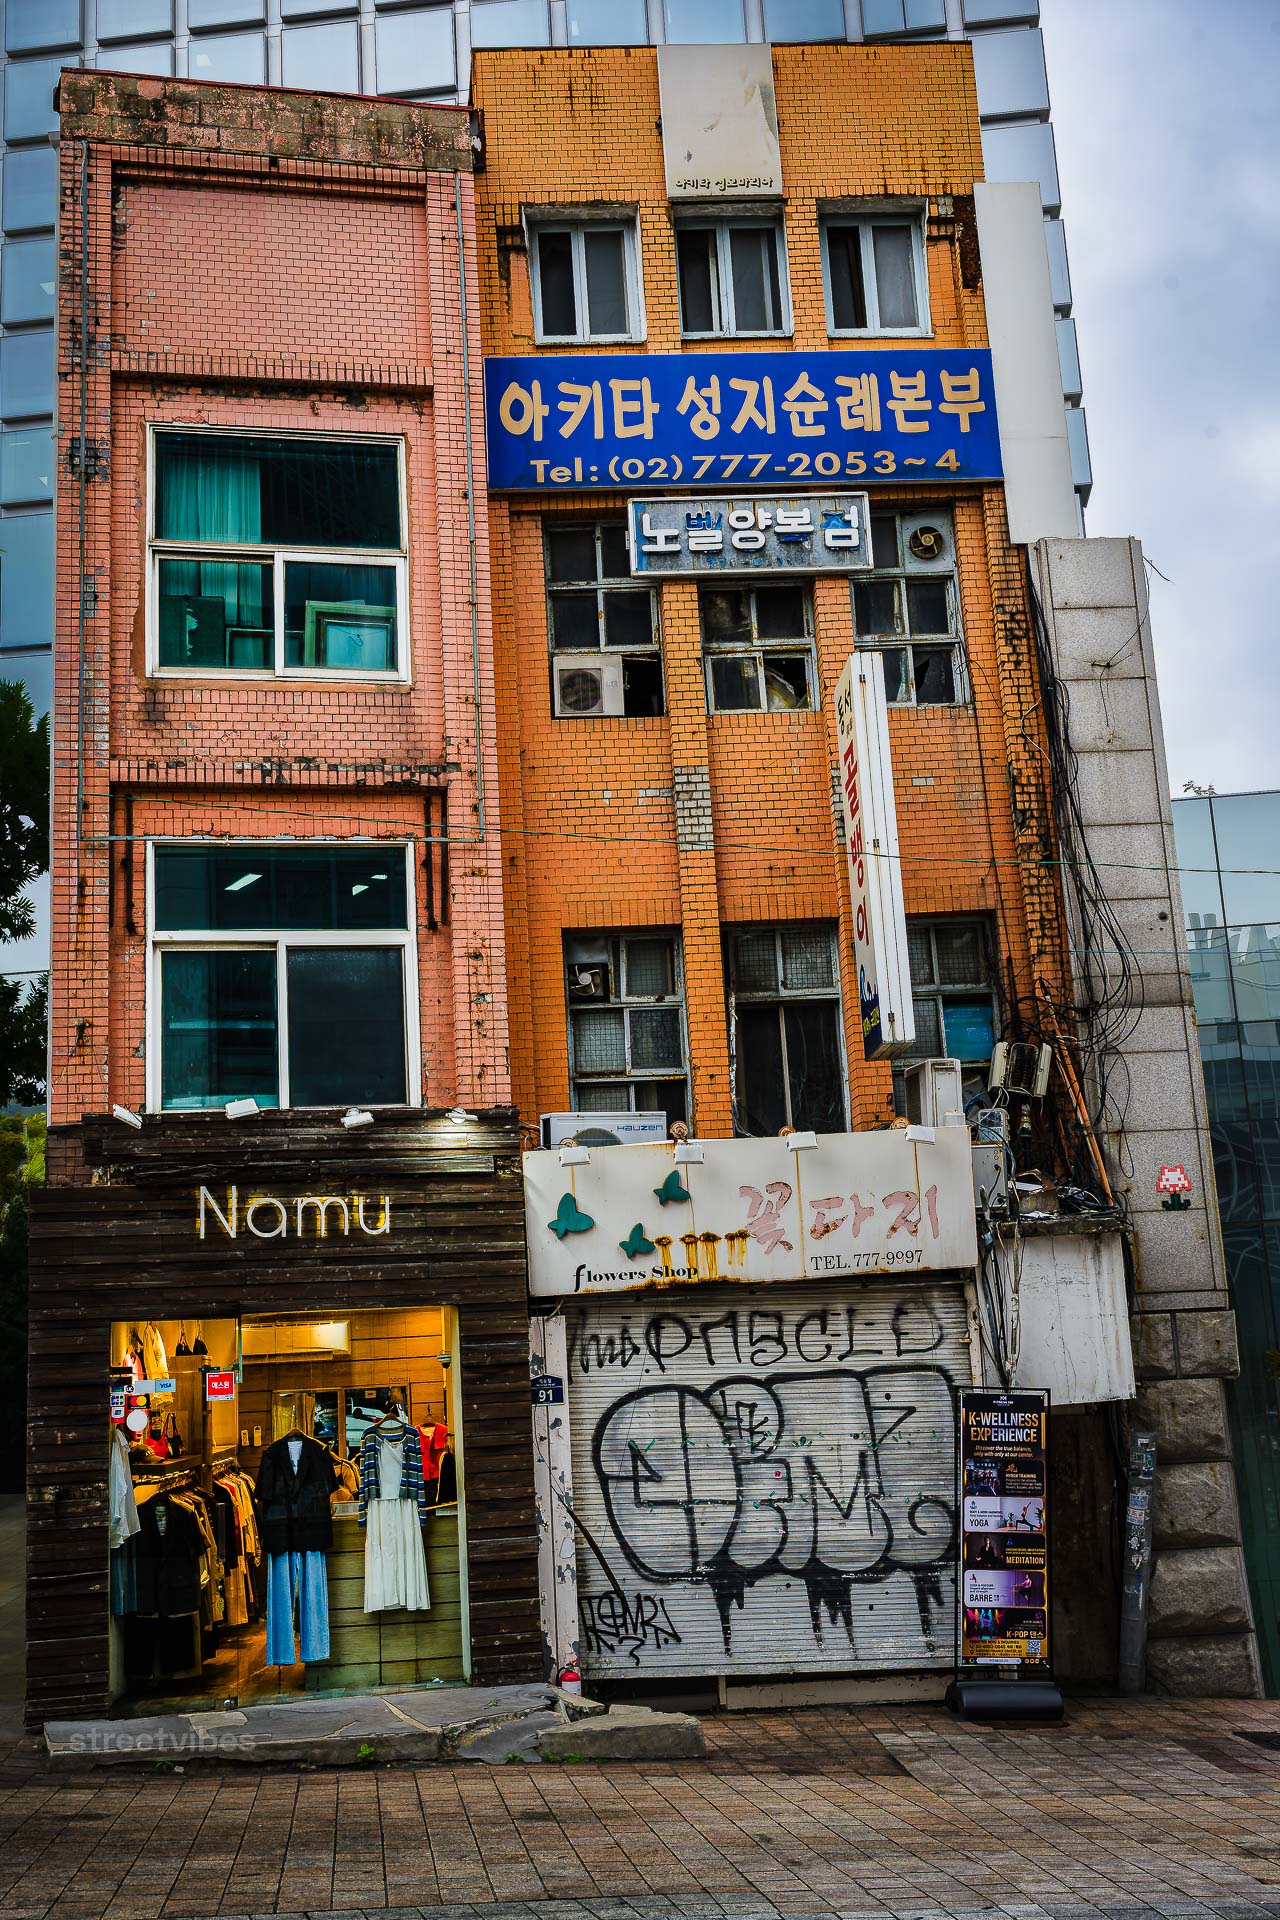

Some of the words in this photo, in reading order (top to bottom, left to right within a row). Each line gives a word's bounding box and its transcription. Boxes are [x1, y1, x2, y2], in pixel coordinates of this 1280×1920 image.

[499, 376, 660, 442] 아키타
[676, 367, 986, 441] 성지순례본부
[529, 456, 600, 484] Tel:
[608, 454, 684, 482] (02)
[199, 1185, 390, 1239] Namu
[738, 1181, 940, 1255] 꽃다지
[573, 1263, 647, 1293] flowers
[651, 1265, 699, 1281] Shop
[538, 1389, 553, 1402] 91
[968, 1411, 1039, 1427] K-WELLNESS
[970, 1427, 1037, 1442] EXPERIENCE
[969, 1519, 990, 1527] YOGA
[1005, 1556, 1044, 1565] MEDITATION
[969, 1594, 993, 1602] BARRE
[1006, 1630, 1029, 1638] K-POP
[1029, 1630, 1044, 1639] 댄스
